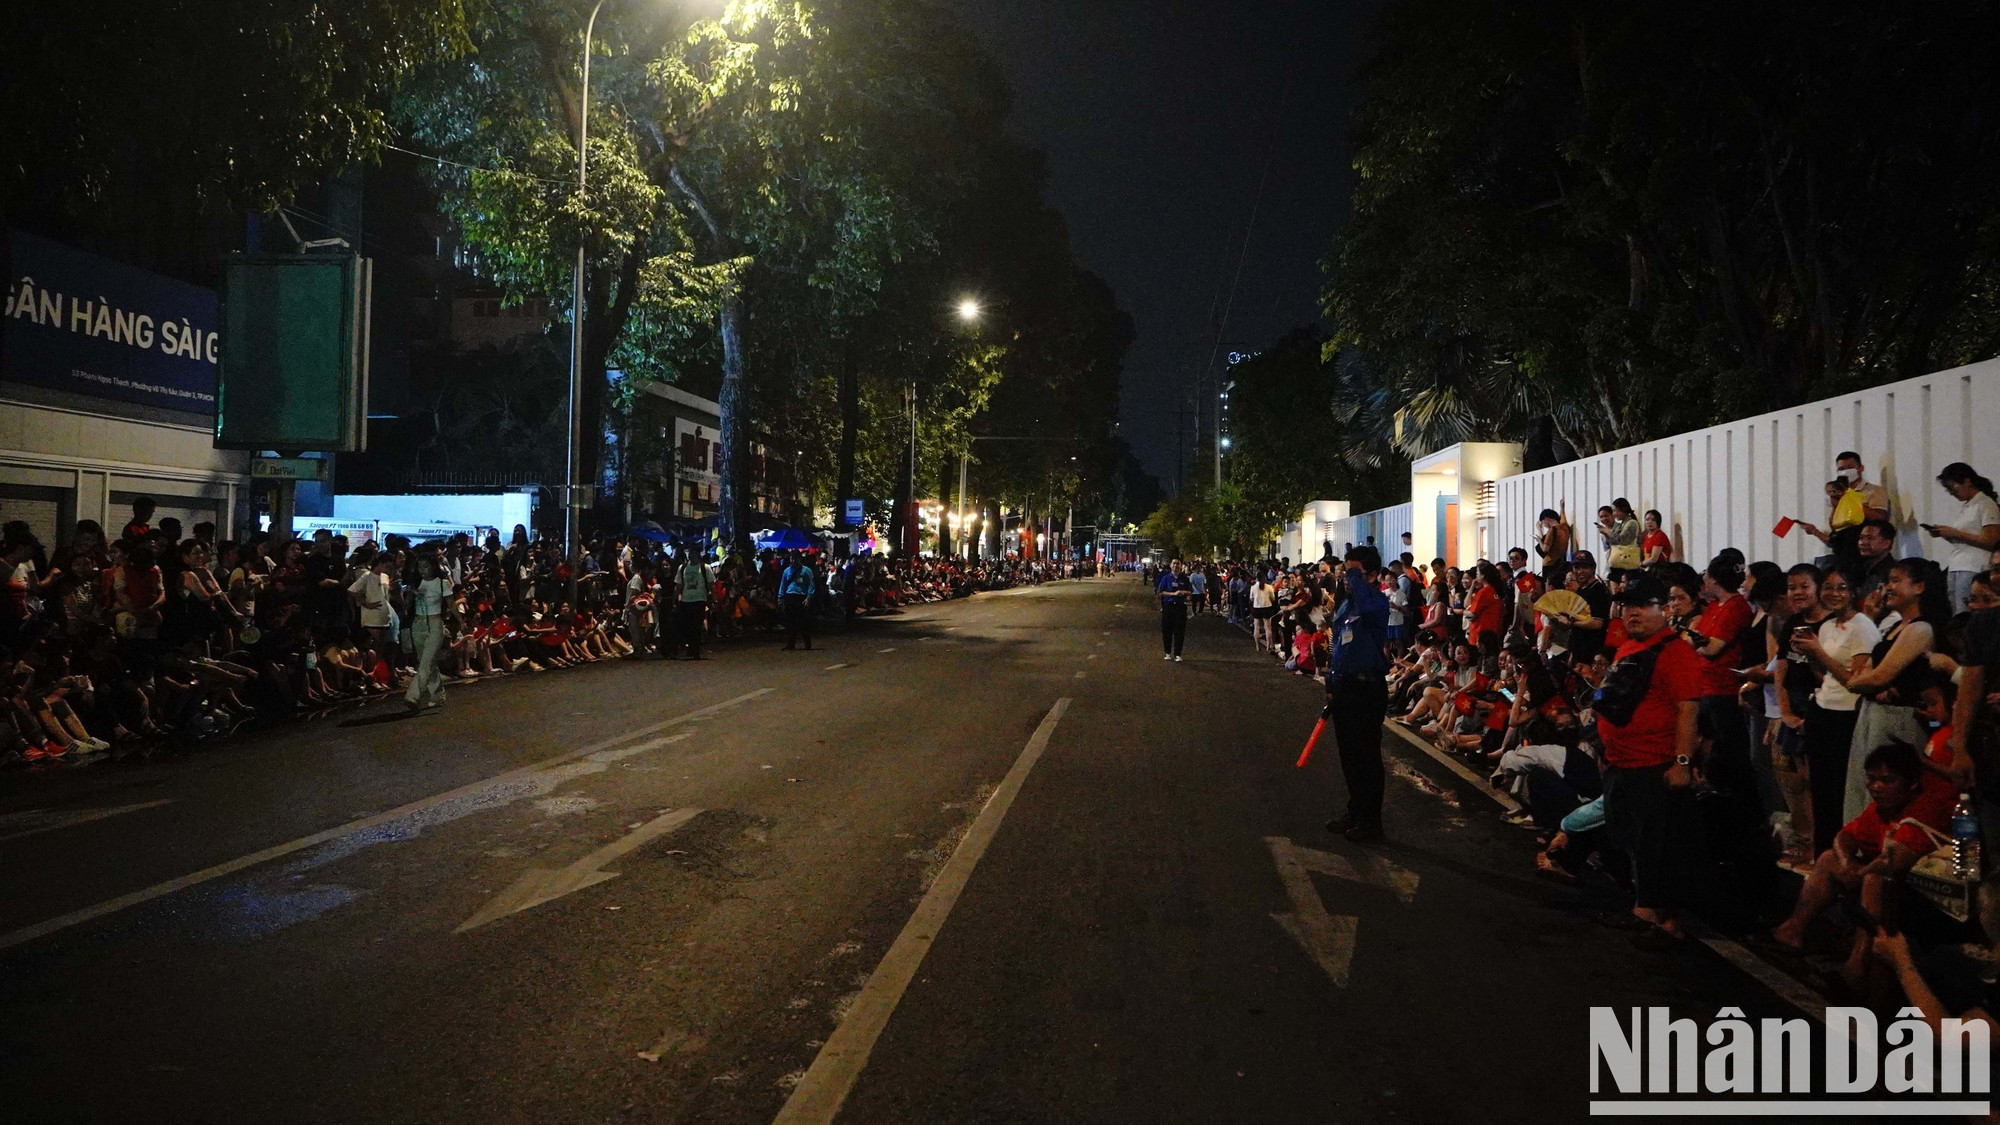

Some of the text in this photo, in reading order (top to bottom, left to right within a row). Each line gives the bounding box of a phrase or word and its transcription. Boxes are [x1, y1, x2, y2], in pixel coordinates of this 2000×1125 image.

[71, 296, 154, 349] HÀNG
[161, 317, 201, 361] SÀI
[206, 331, 219, 365] G
